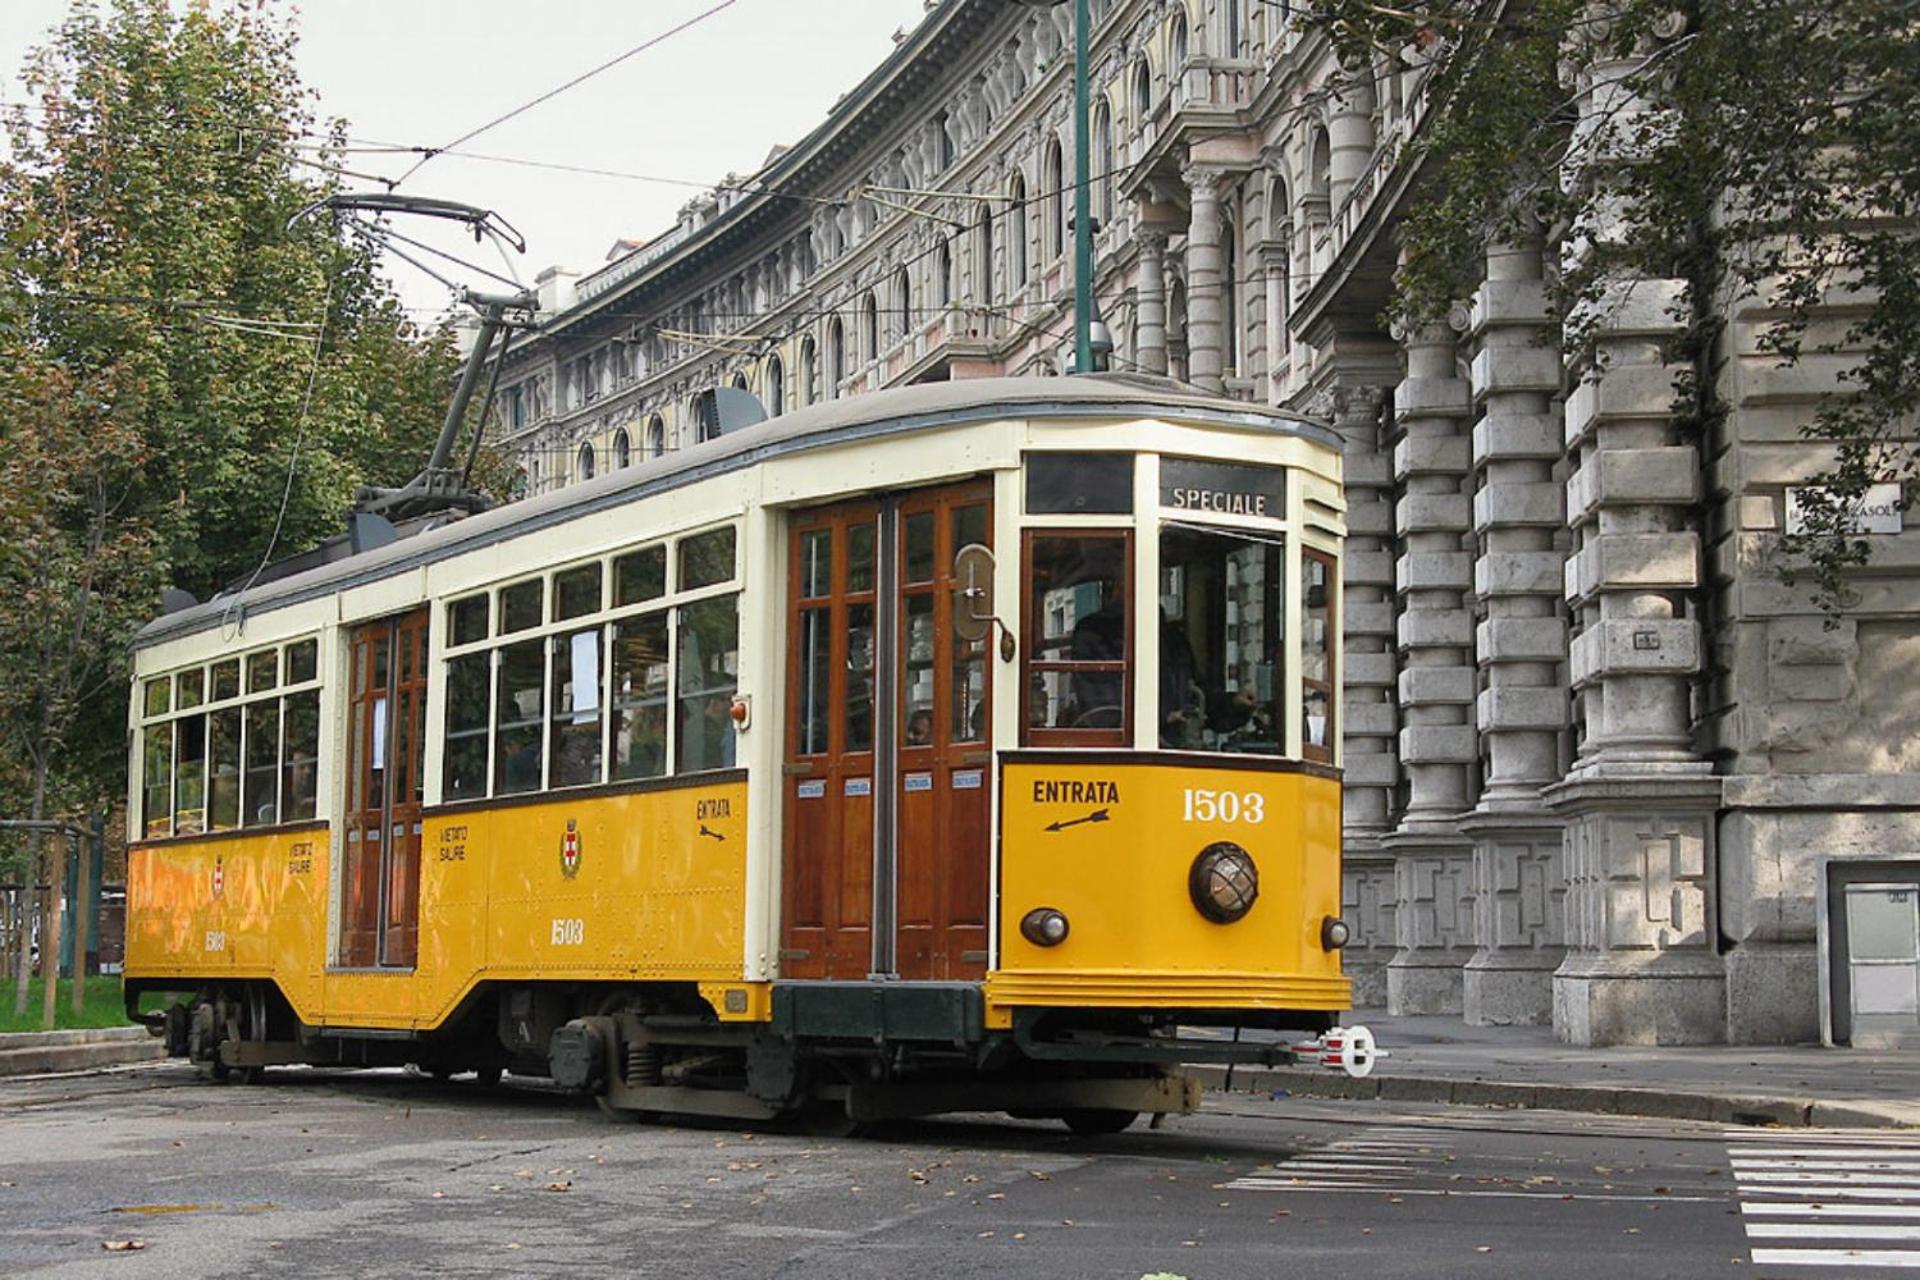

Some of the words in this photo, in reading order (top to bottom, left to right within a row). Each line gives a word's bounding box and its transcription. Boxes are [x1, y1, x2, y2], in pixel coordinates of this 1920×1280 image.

[1173, 487, 1266, 516] SPECIALE
[1033, 780, 1119, 804] ENTRATA
[696, 798, 731, 820] ENTRATA
[1183, 789, 1264, 824] 1503
[550, 918, 584, 946] 1503
